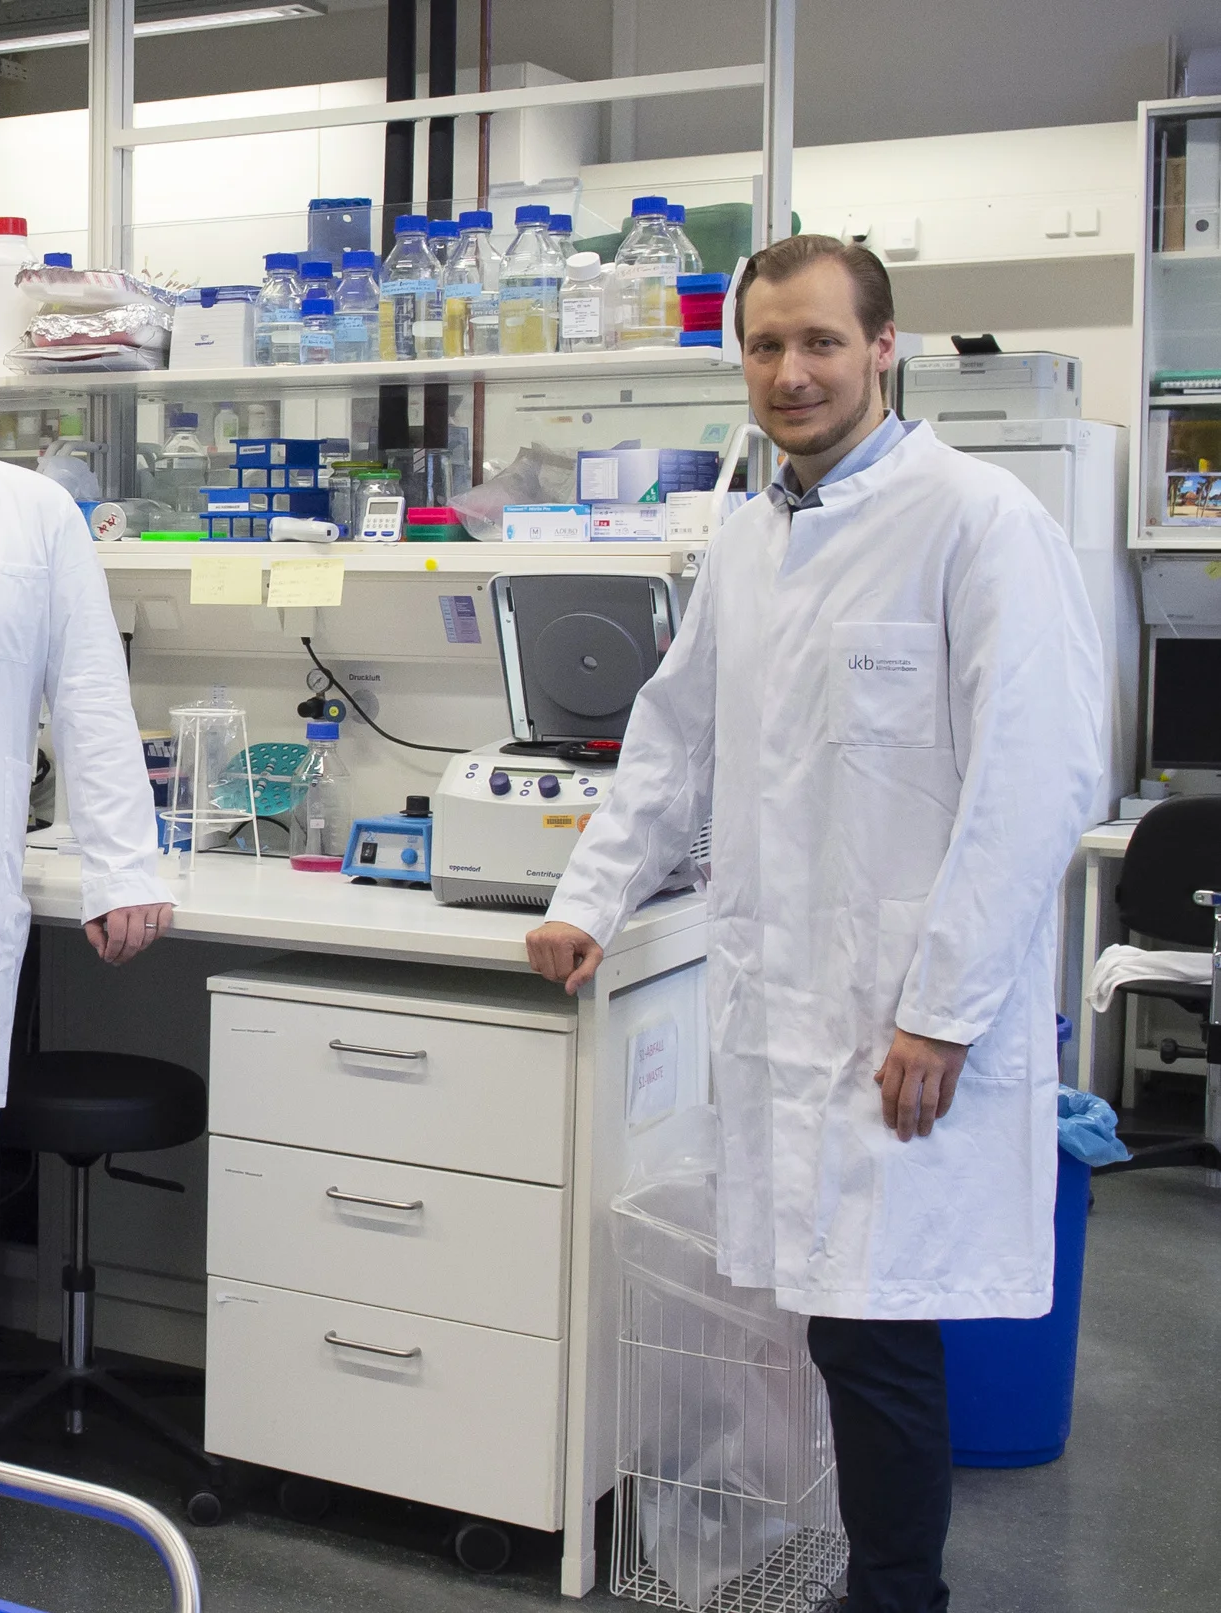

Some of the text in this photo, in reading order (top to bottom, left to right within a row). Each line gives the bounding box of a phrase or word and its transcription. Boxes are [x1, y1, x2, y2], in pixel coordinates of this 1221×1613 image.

[848, 654, 874, 671] ukb
[348, 673, 381, 682] Druckluft
[448, 864, 482, 873] eppendorf
